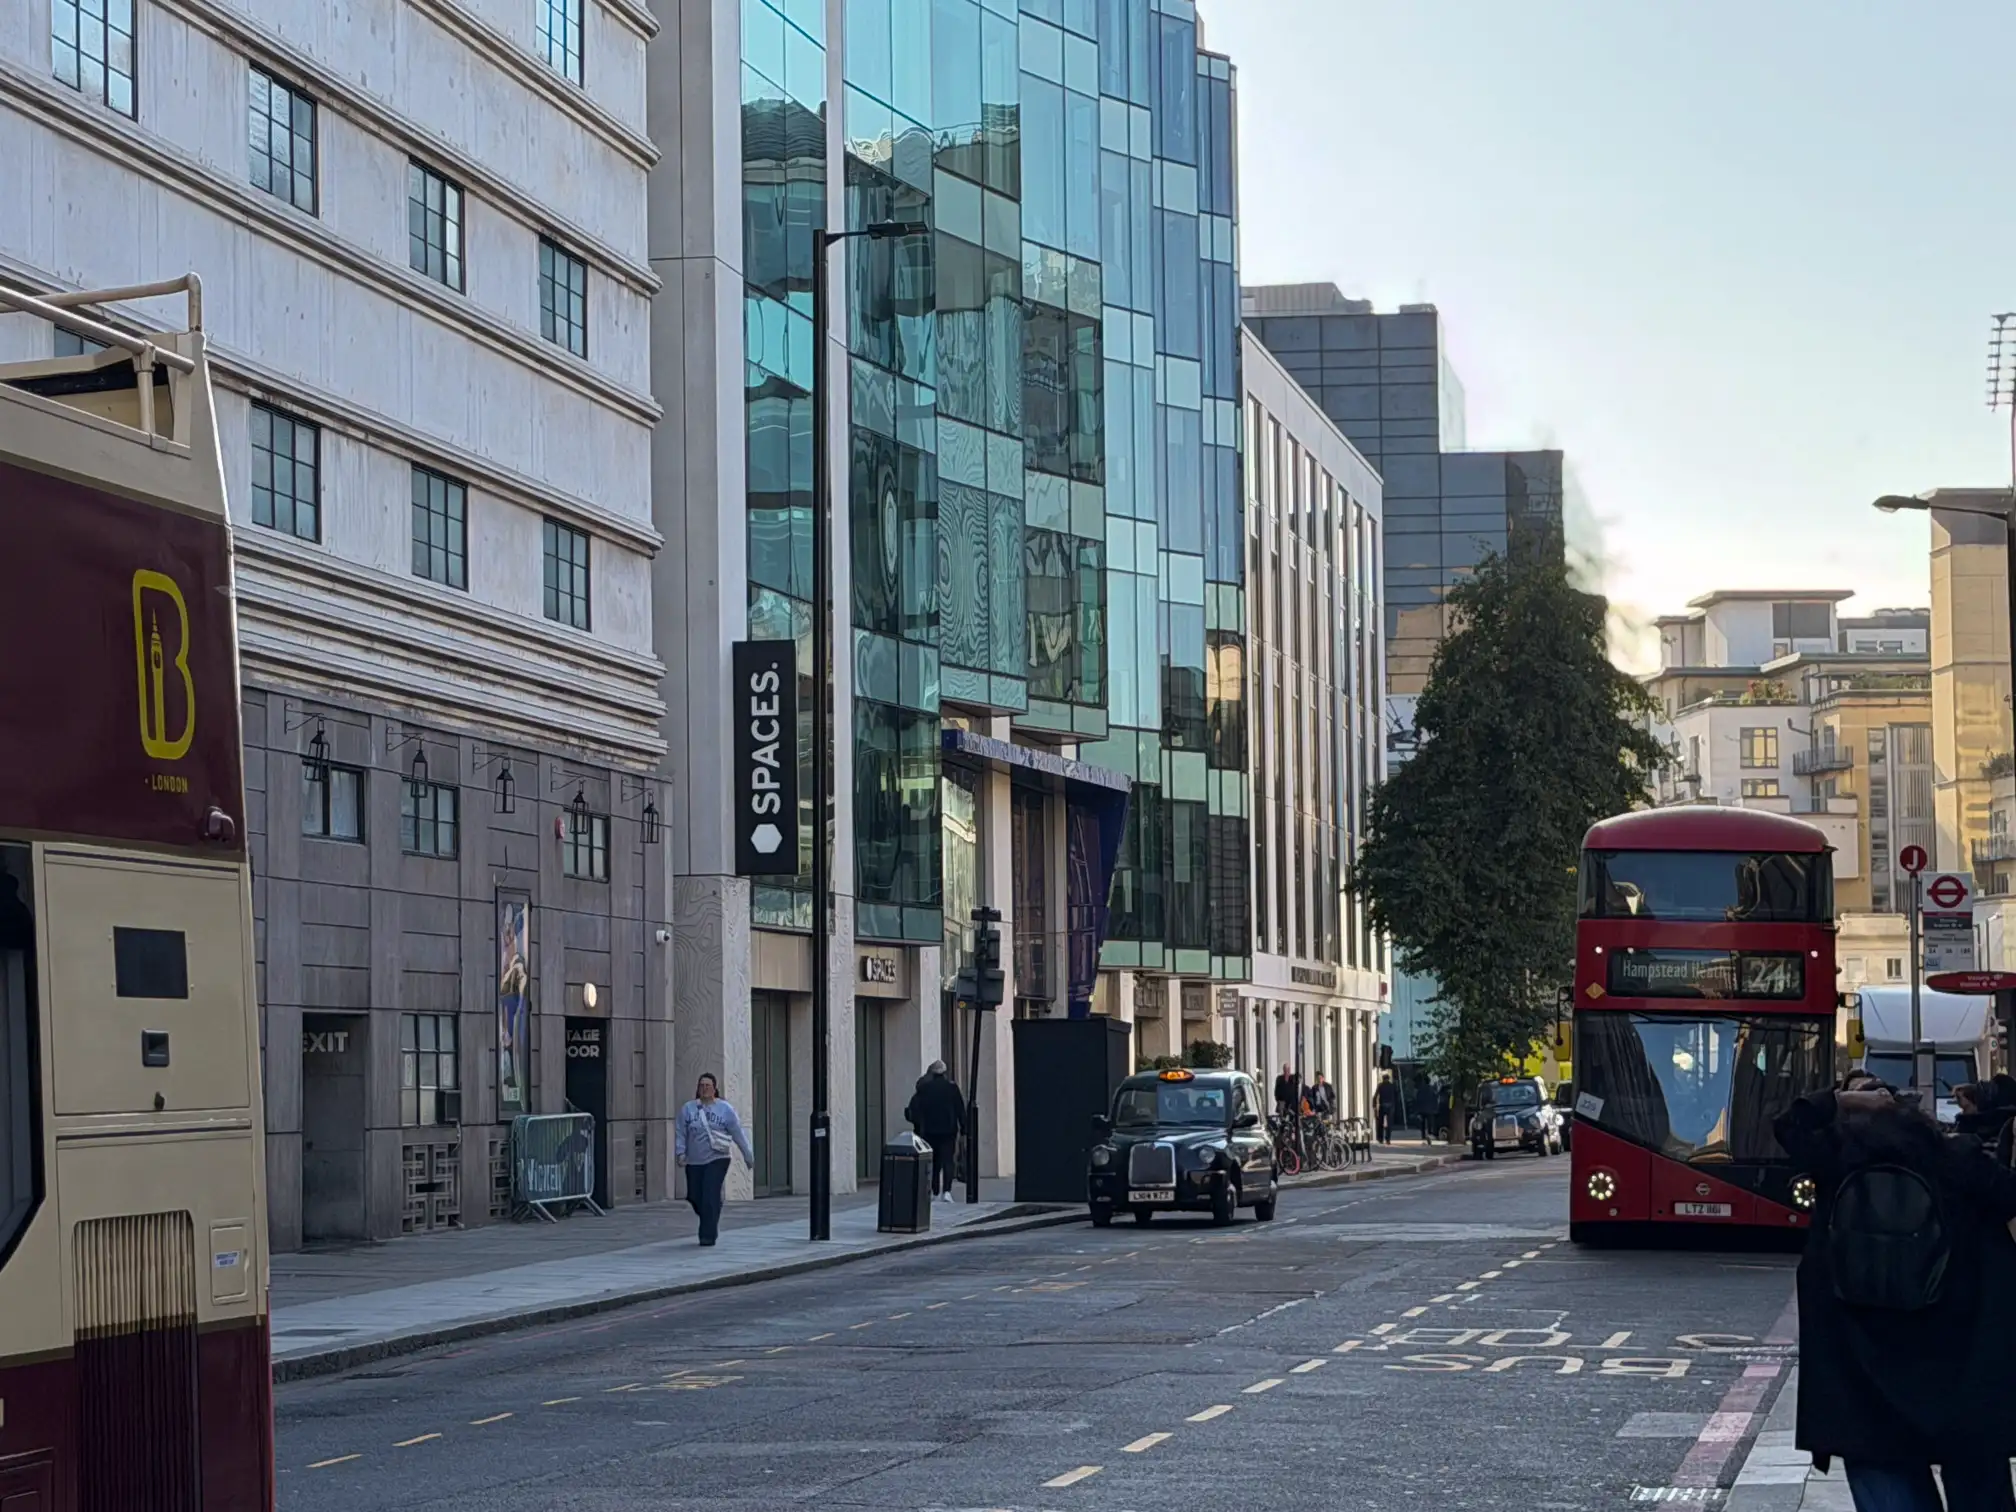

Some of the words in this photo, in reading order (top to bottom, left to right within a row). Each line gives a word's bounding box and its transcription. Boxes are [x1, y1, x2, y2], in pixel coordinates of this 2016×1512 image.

[152, 774, 188, 793] LONDON
[1906, 849, 1919, 870] J
[1623, 959, 1689, 988] Hampstead
[566, 1029, 600, 1041] TAGE
[567, 1045, 600, 1057] OOR
[1383, 1353, 1692, 1377] BUS
